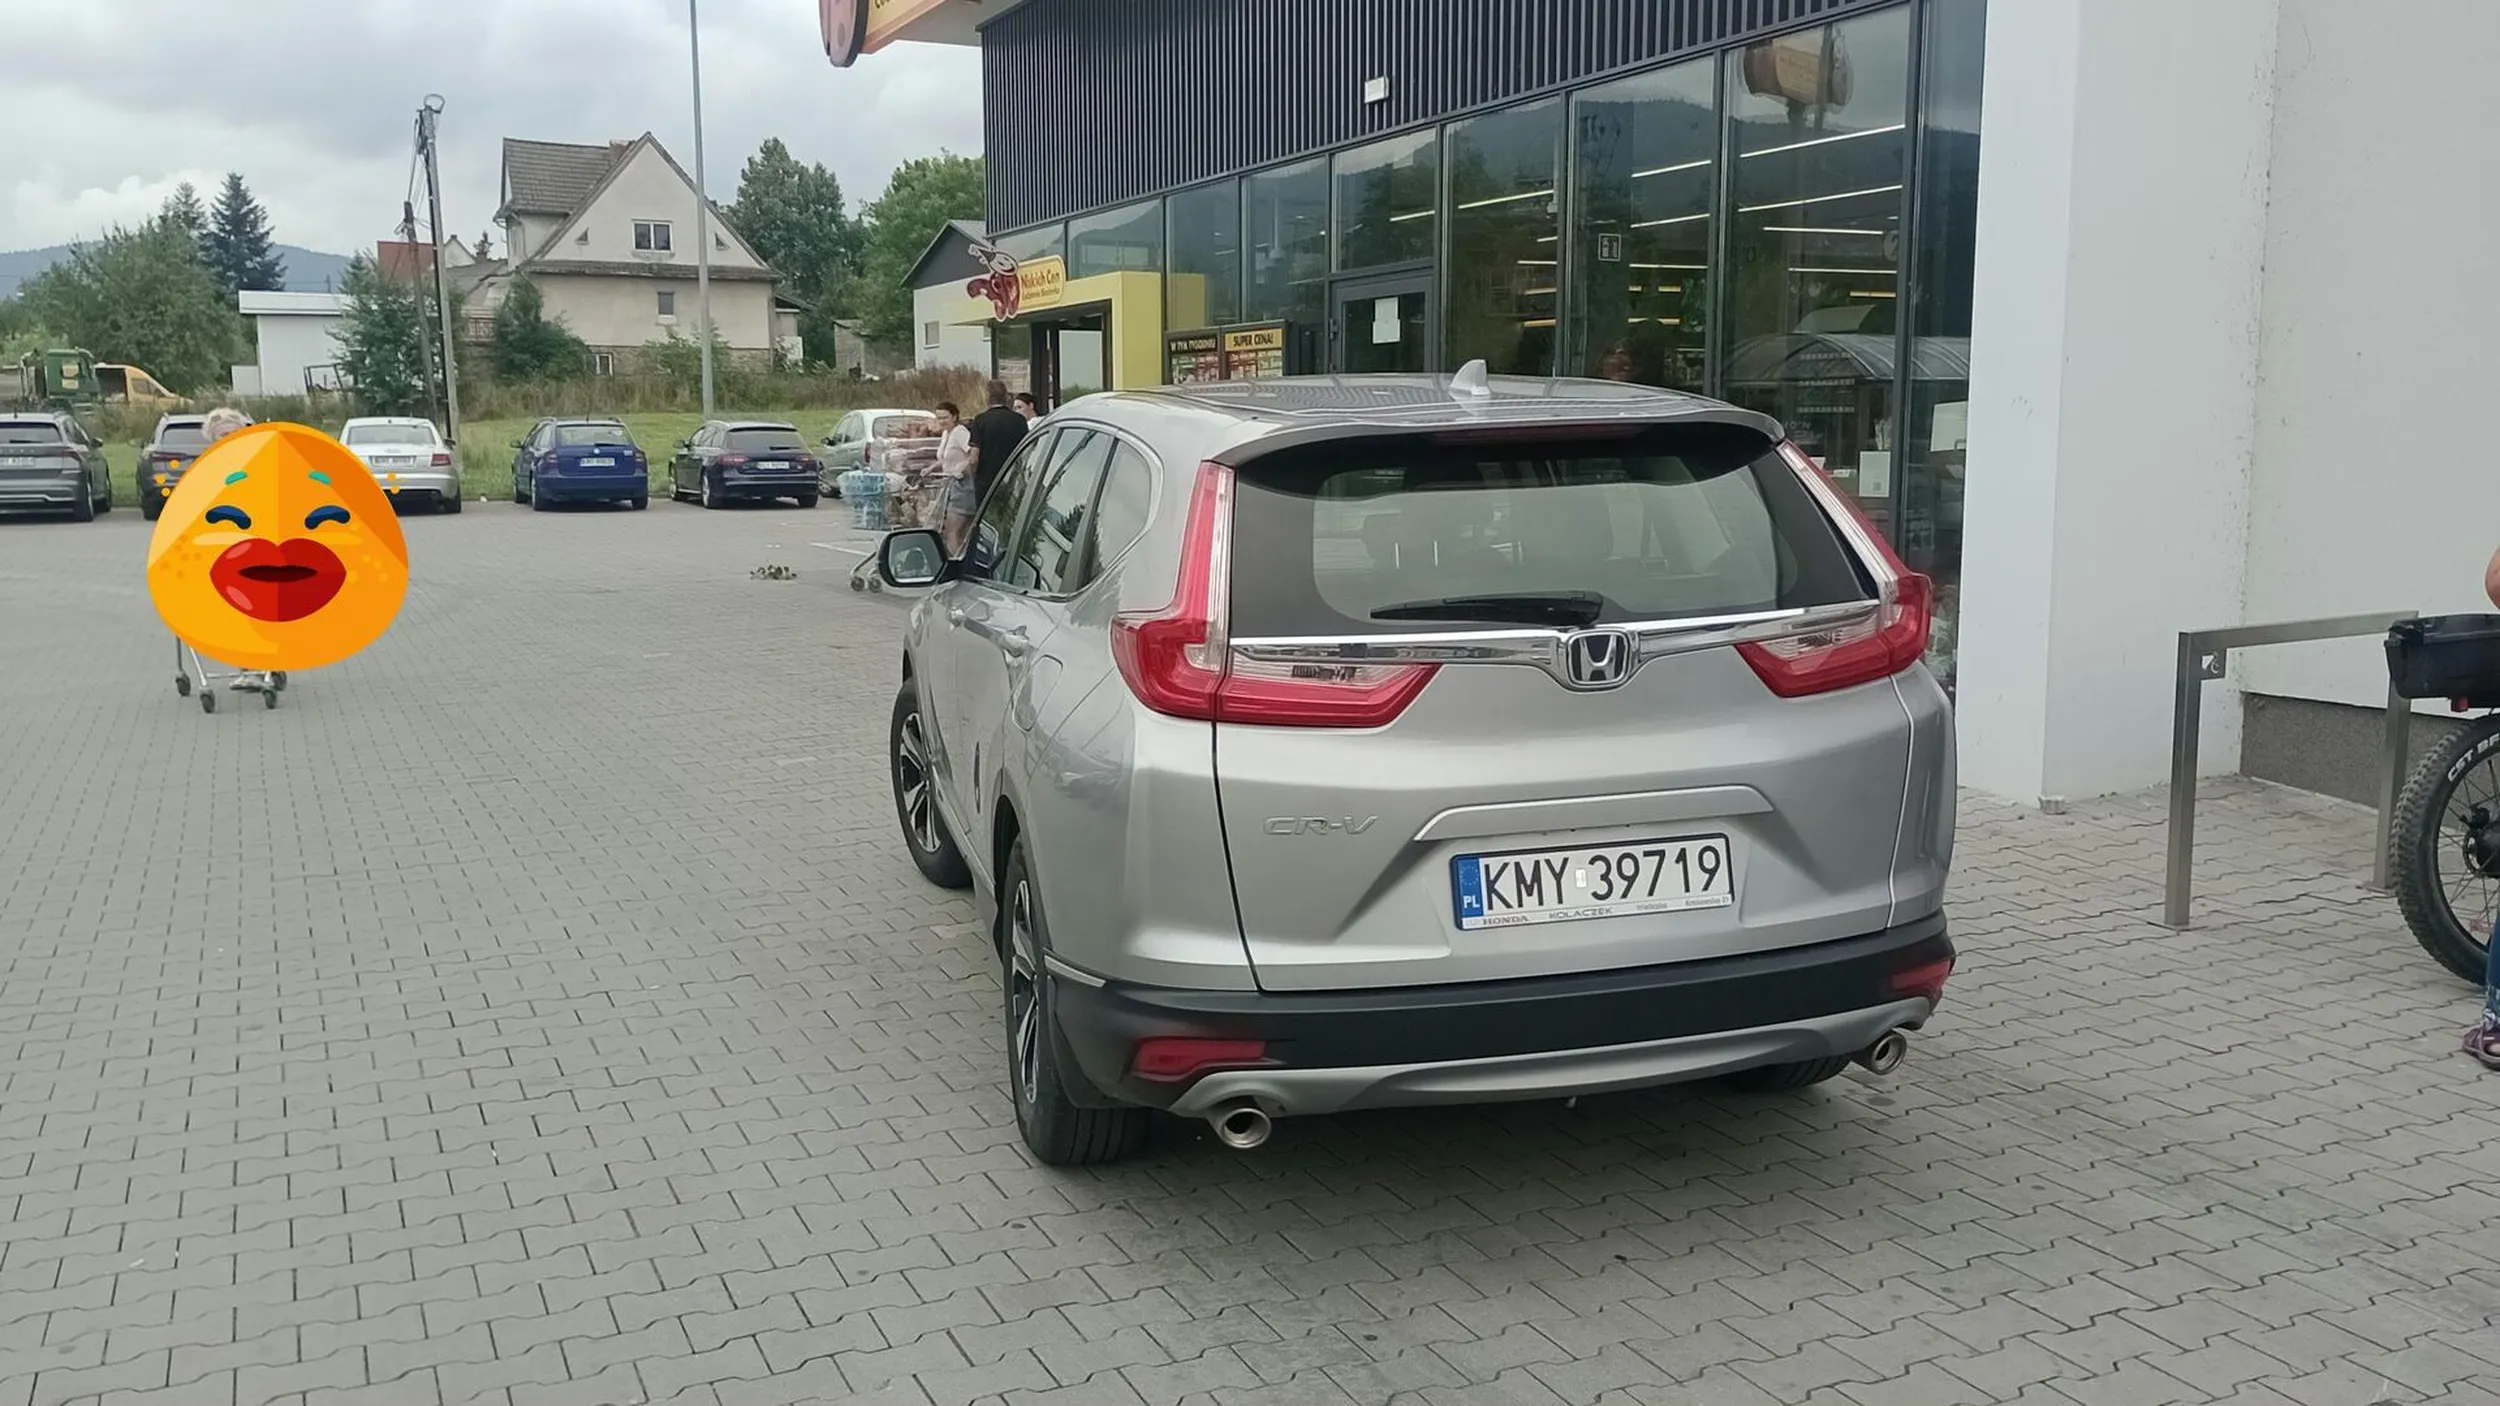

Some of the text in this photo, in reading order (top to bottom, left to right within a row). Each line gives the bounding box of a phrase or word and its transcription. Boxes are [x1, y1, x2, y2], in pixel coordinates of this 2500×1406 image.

[1233, 334, 1252, 346] SUPER
[2448, 749, 2473, 782] CST
[1264, 815, 1377, 835] CR-V
[1484, 845, 1720, 910] KMY 39719
[1463, 895, 1480, 908] PL
[1483, 915, 1529, 925] HONDA
